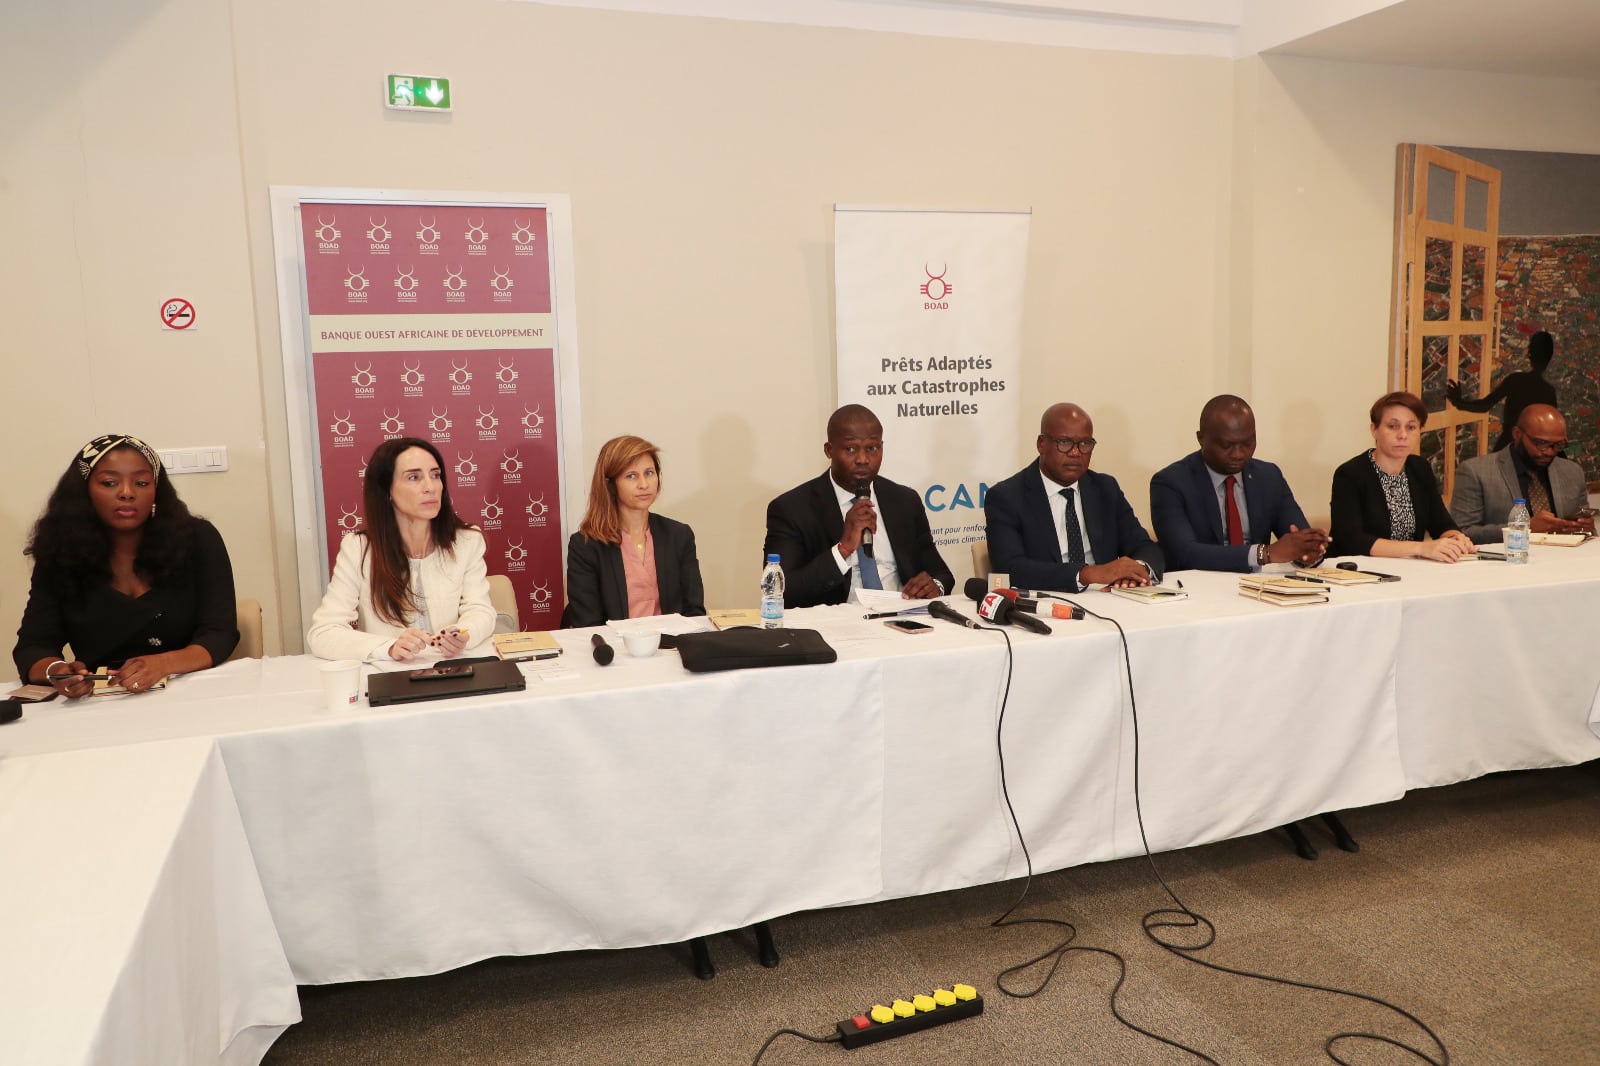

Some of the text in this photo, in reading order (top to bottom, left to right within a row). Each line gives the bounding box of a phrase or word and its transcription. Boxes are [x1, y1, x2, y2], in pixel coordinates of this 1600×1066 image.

[924, 302, 949, 310] BOAD
[321, 331, 361, 340] BANQUE
[364, 331, 396, 339] OUEST
[398, 329, 449, 339] AFRICAINE
[451, 329, 464, 338] DE
[881, 355, 993, 374] Prêts Adaptés
[867, 377, 1006, 396] aux Catastrophes
[897, 400, 979, 418] Naturelles
[944, 526, 961, 536] pour
